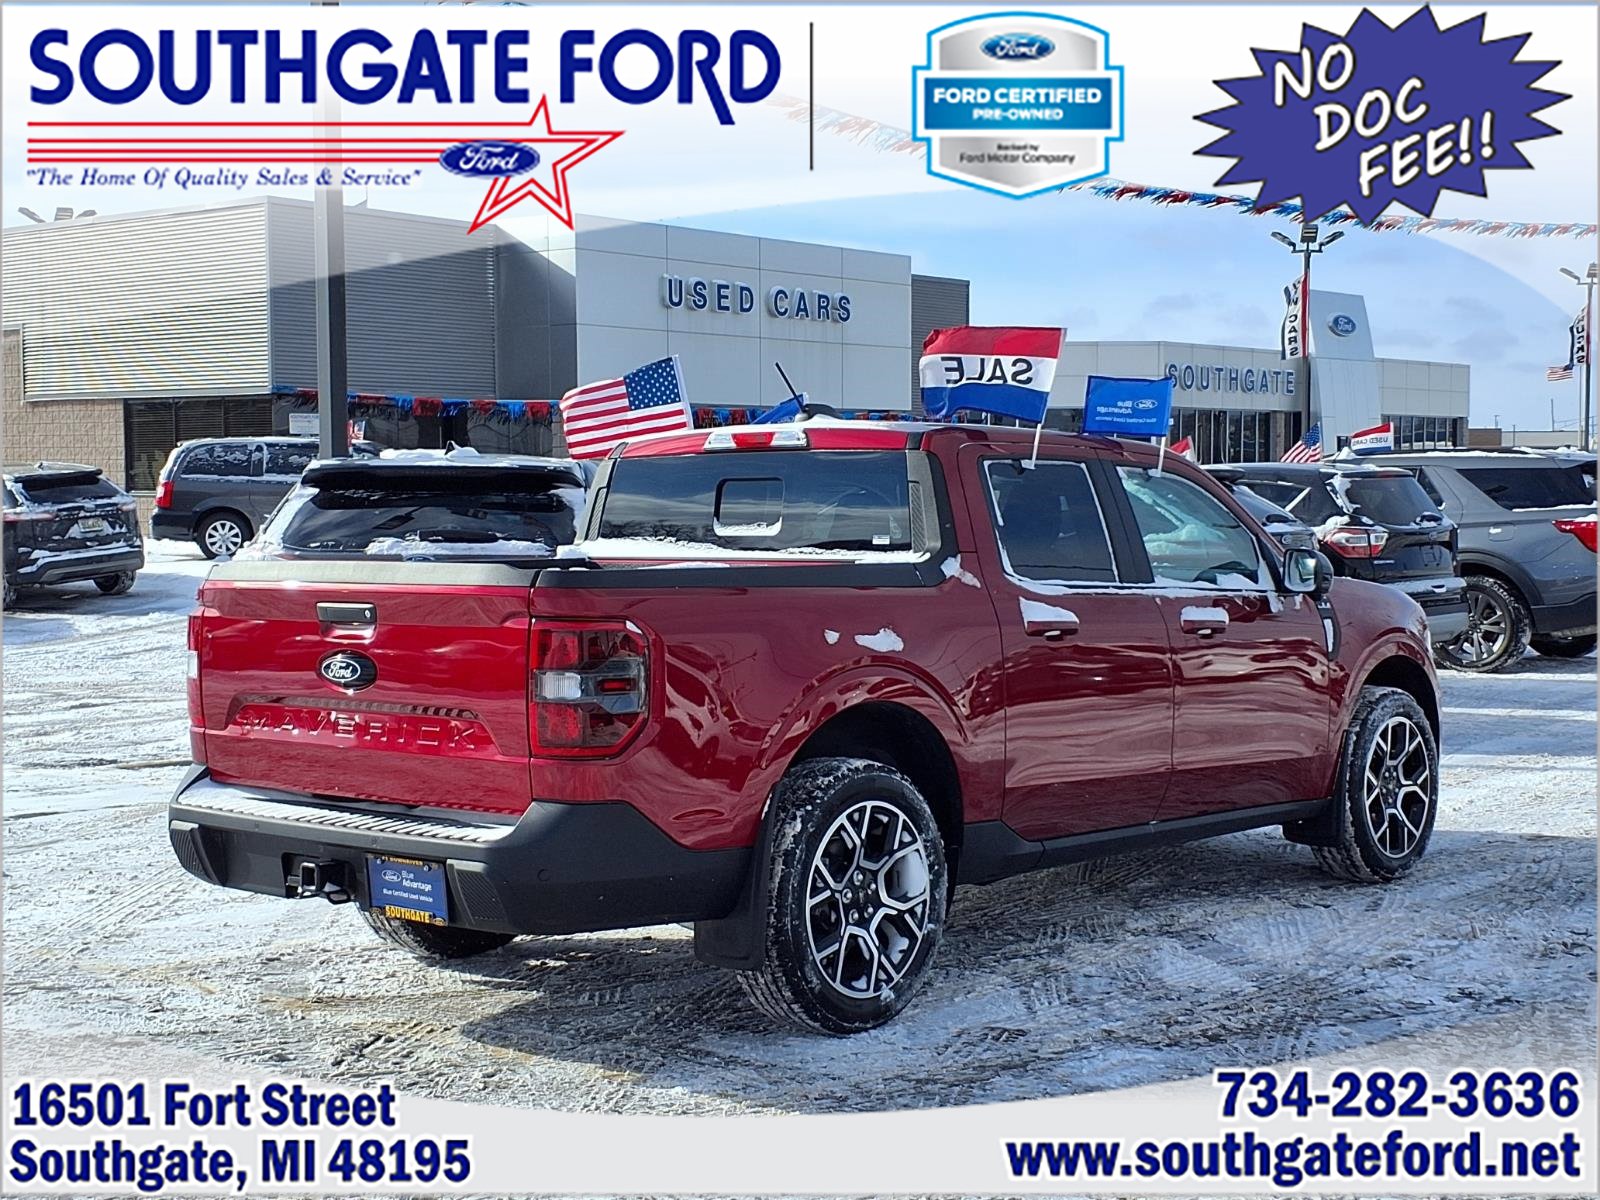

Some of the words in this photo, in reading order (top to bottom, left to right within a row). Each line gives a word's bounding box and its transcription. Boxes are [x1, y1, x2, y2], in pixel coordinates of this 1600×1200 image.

[665, 276, 755, 314] USED
[771, 287, 851, 323] CARS
[1167, 363, 1295, 394] SOUTHGATE
[328, 661, 353, 678] Ford
[239, 709, 475, 749] MAVERICK
[401, 870, 415, 880] Blue
[402, 879, 432, 891] Advantage
[385, 905, 430, 923] SOUTHGATE
